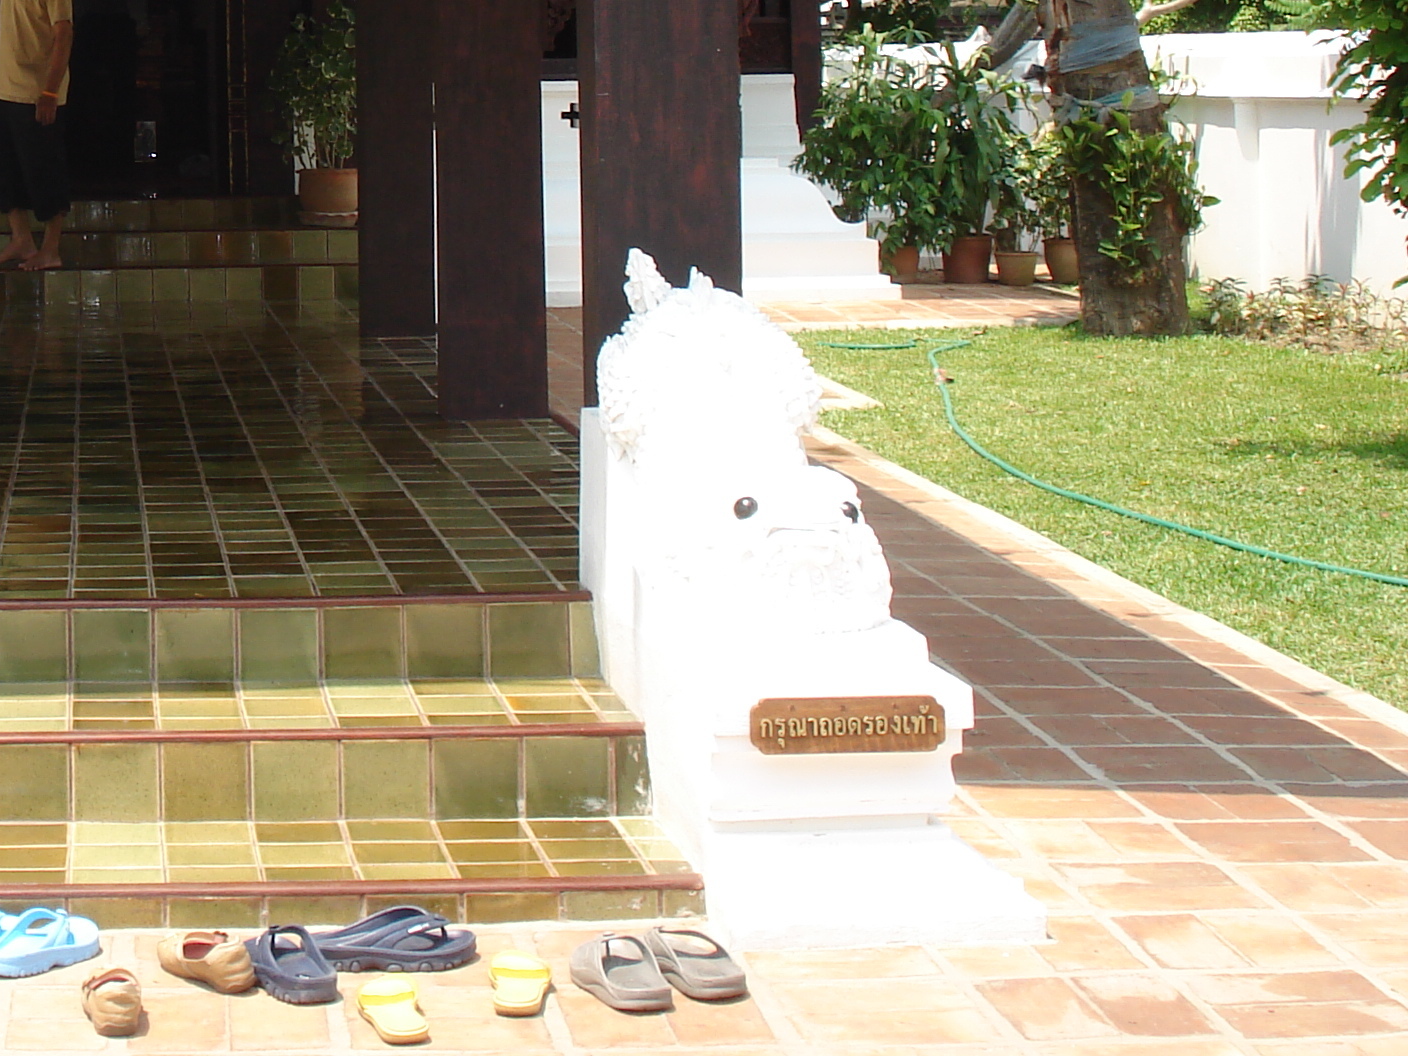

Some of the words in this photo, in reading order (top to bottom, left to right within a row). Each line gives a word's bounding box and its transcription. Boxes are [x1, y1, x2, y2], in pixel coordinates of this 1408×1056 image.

[760, 705, 938, 749] กรุณาถอดรองเท้า
